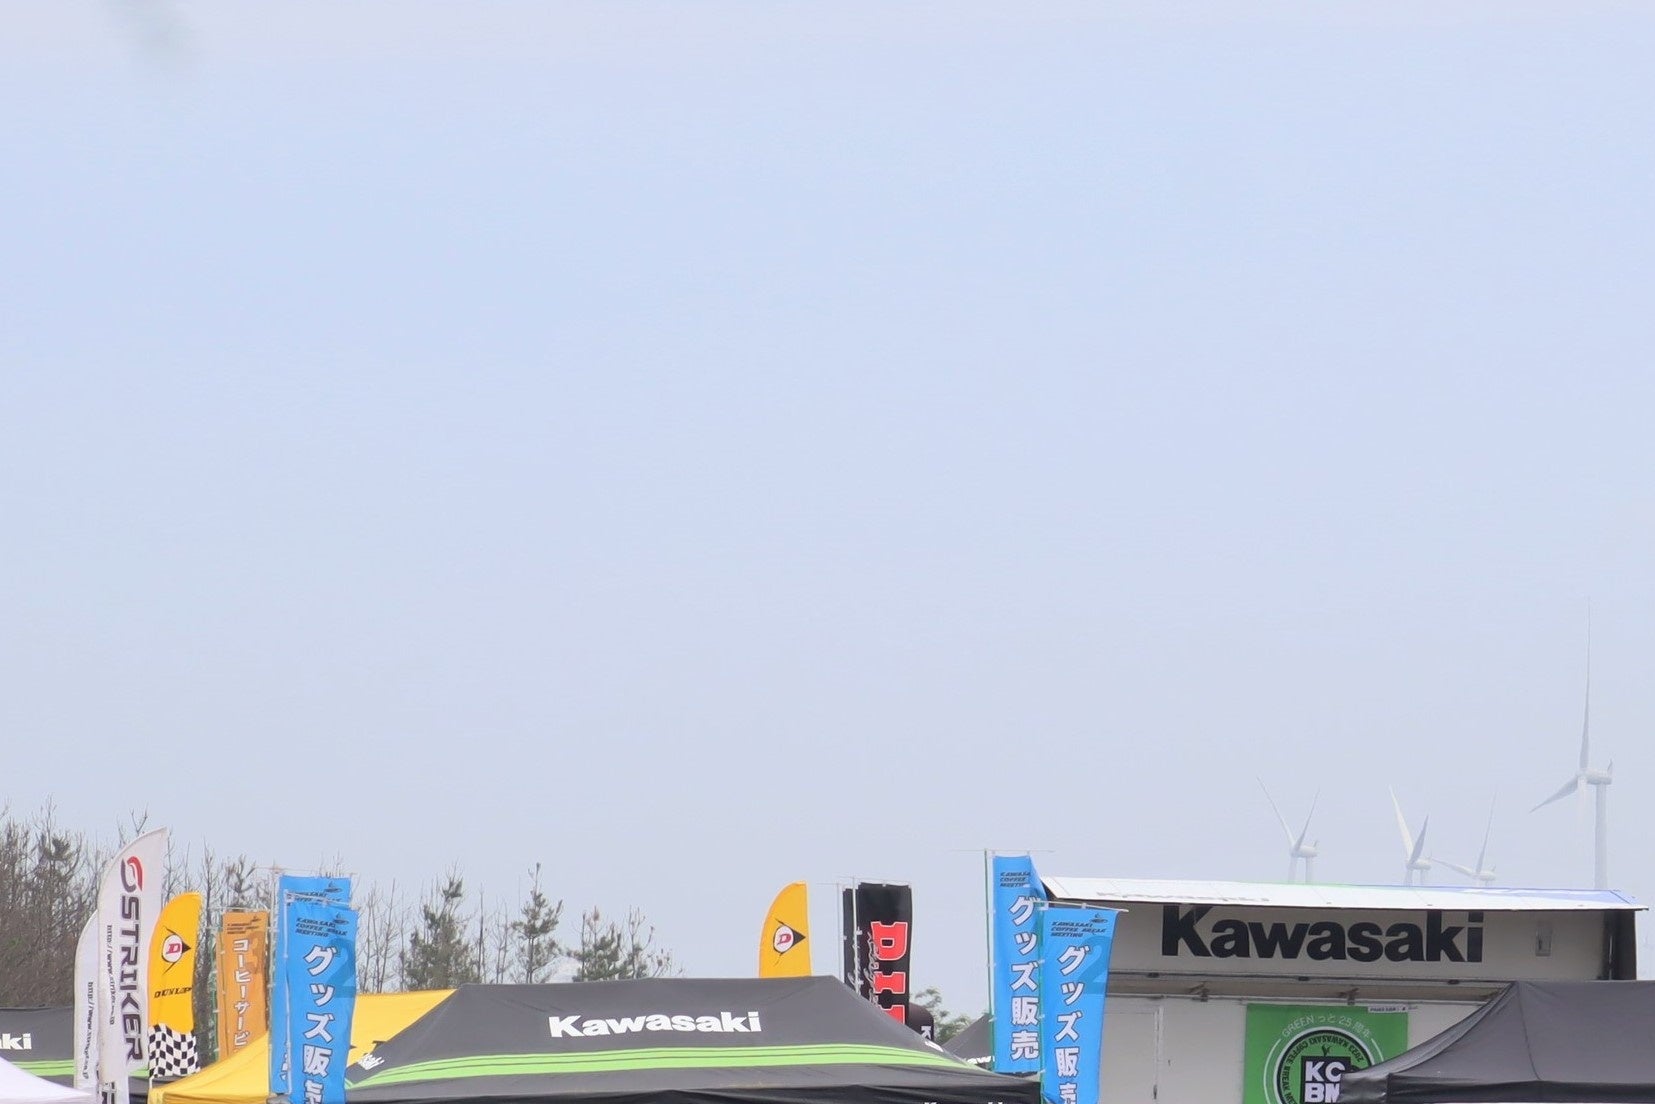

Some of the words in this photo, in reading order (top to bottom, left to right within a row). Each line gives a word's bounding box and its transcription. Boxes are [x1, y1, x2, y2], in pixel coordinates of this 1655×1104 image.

[118, 895, 144, 1068] STRIKER
[1008, 895, 1042, 1061] グッズ販売
[1161, 903, 1485, 964] Kawasaki
[548, 1011, 762, 1038] Kawasaki
